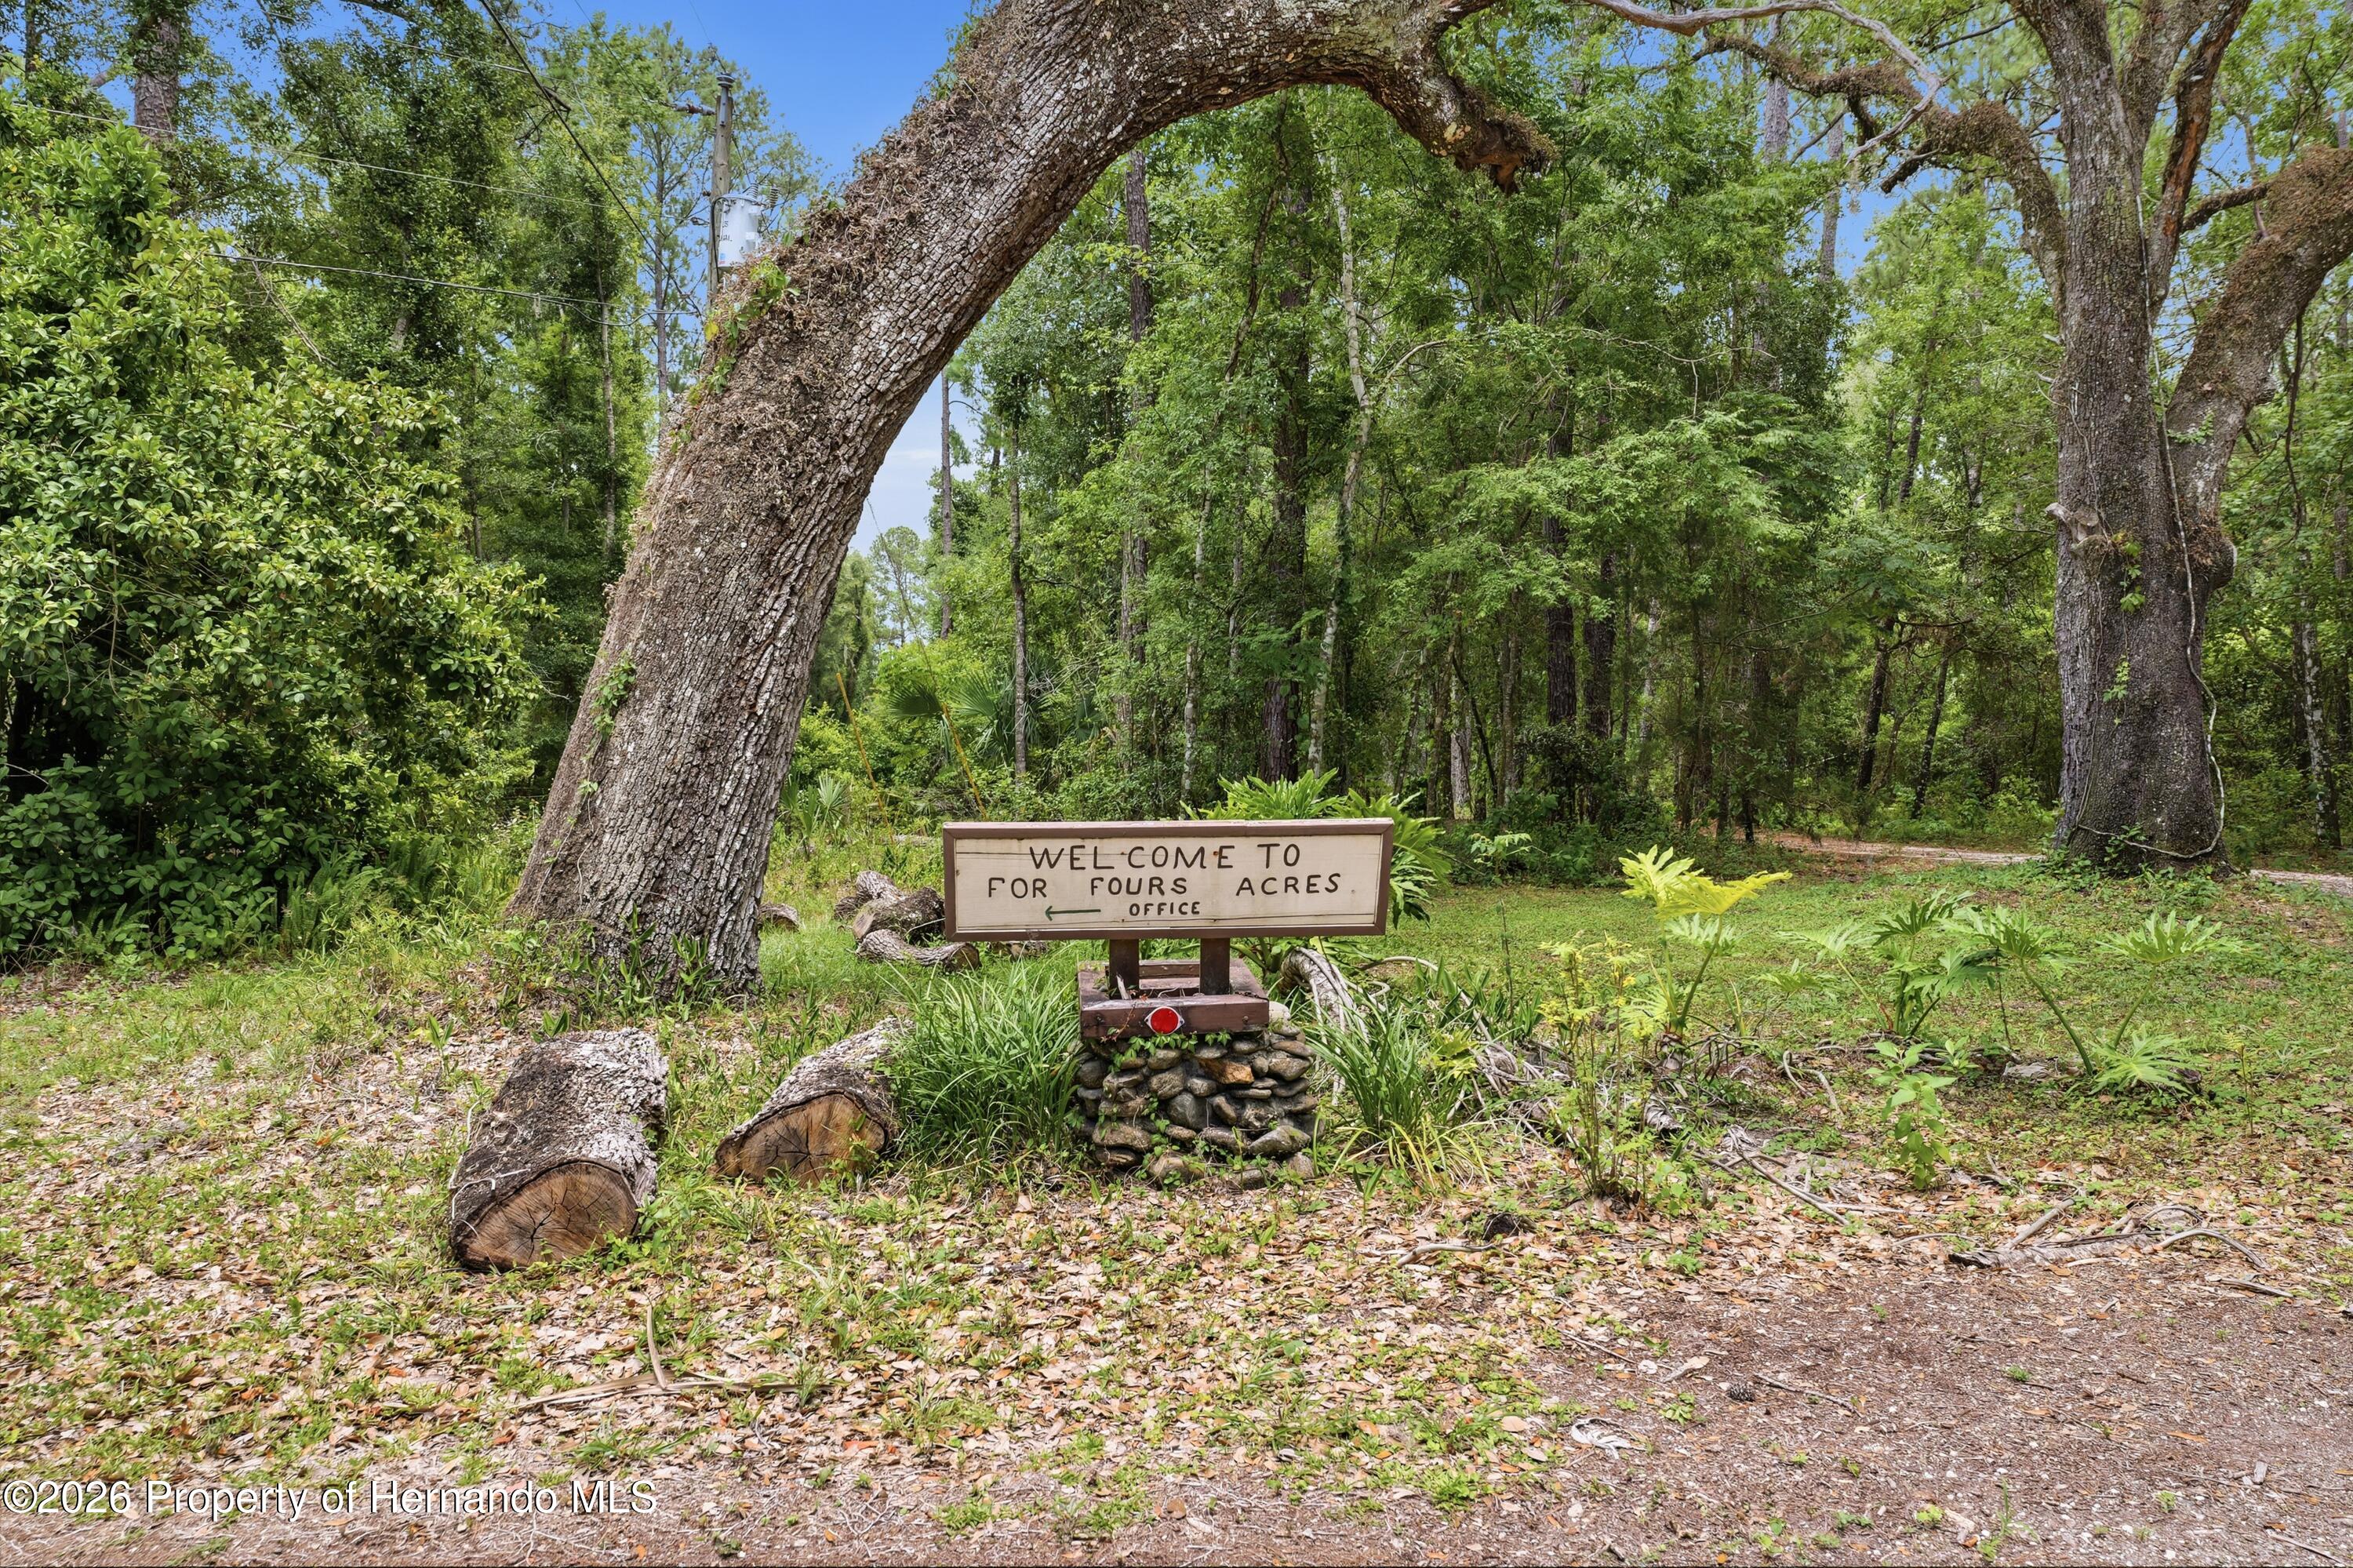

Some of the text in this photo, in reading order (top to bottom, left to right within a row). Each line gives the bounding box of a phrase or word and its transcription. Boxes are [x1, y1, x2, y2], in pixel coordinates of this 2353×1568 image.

[1029, 842, 1300, 871] WELCOME TO
[987, 872, 1342, 899] FOR FOURS ACRES
[1129, 901, 1200, 917] OFFICE
